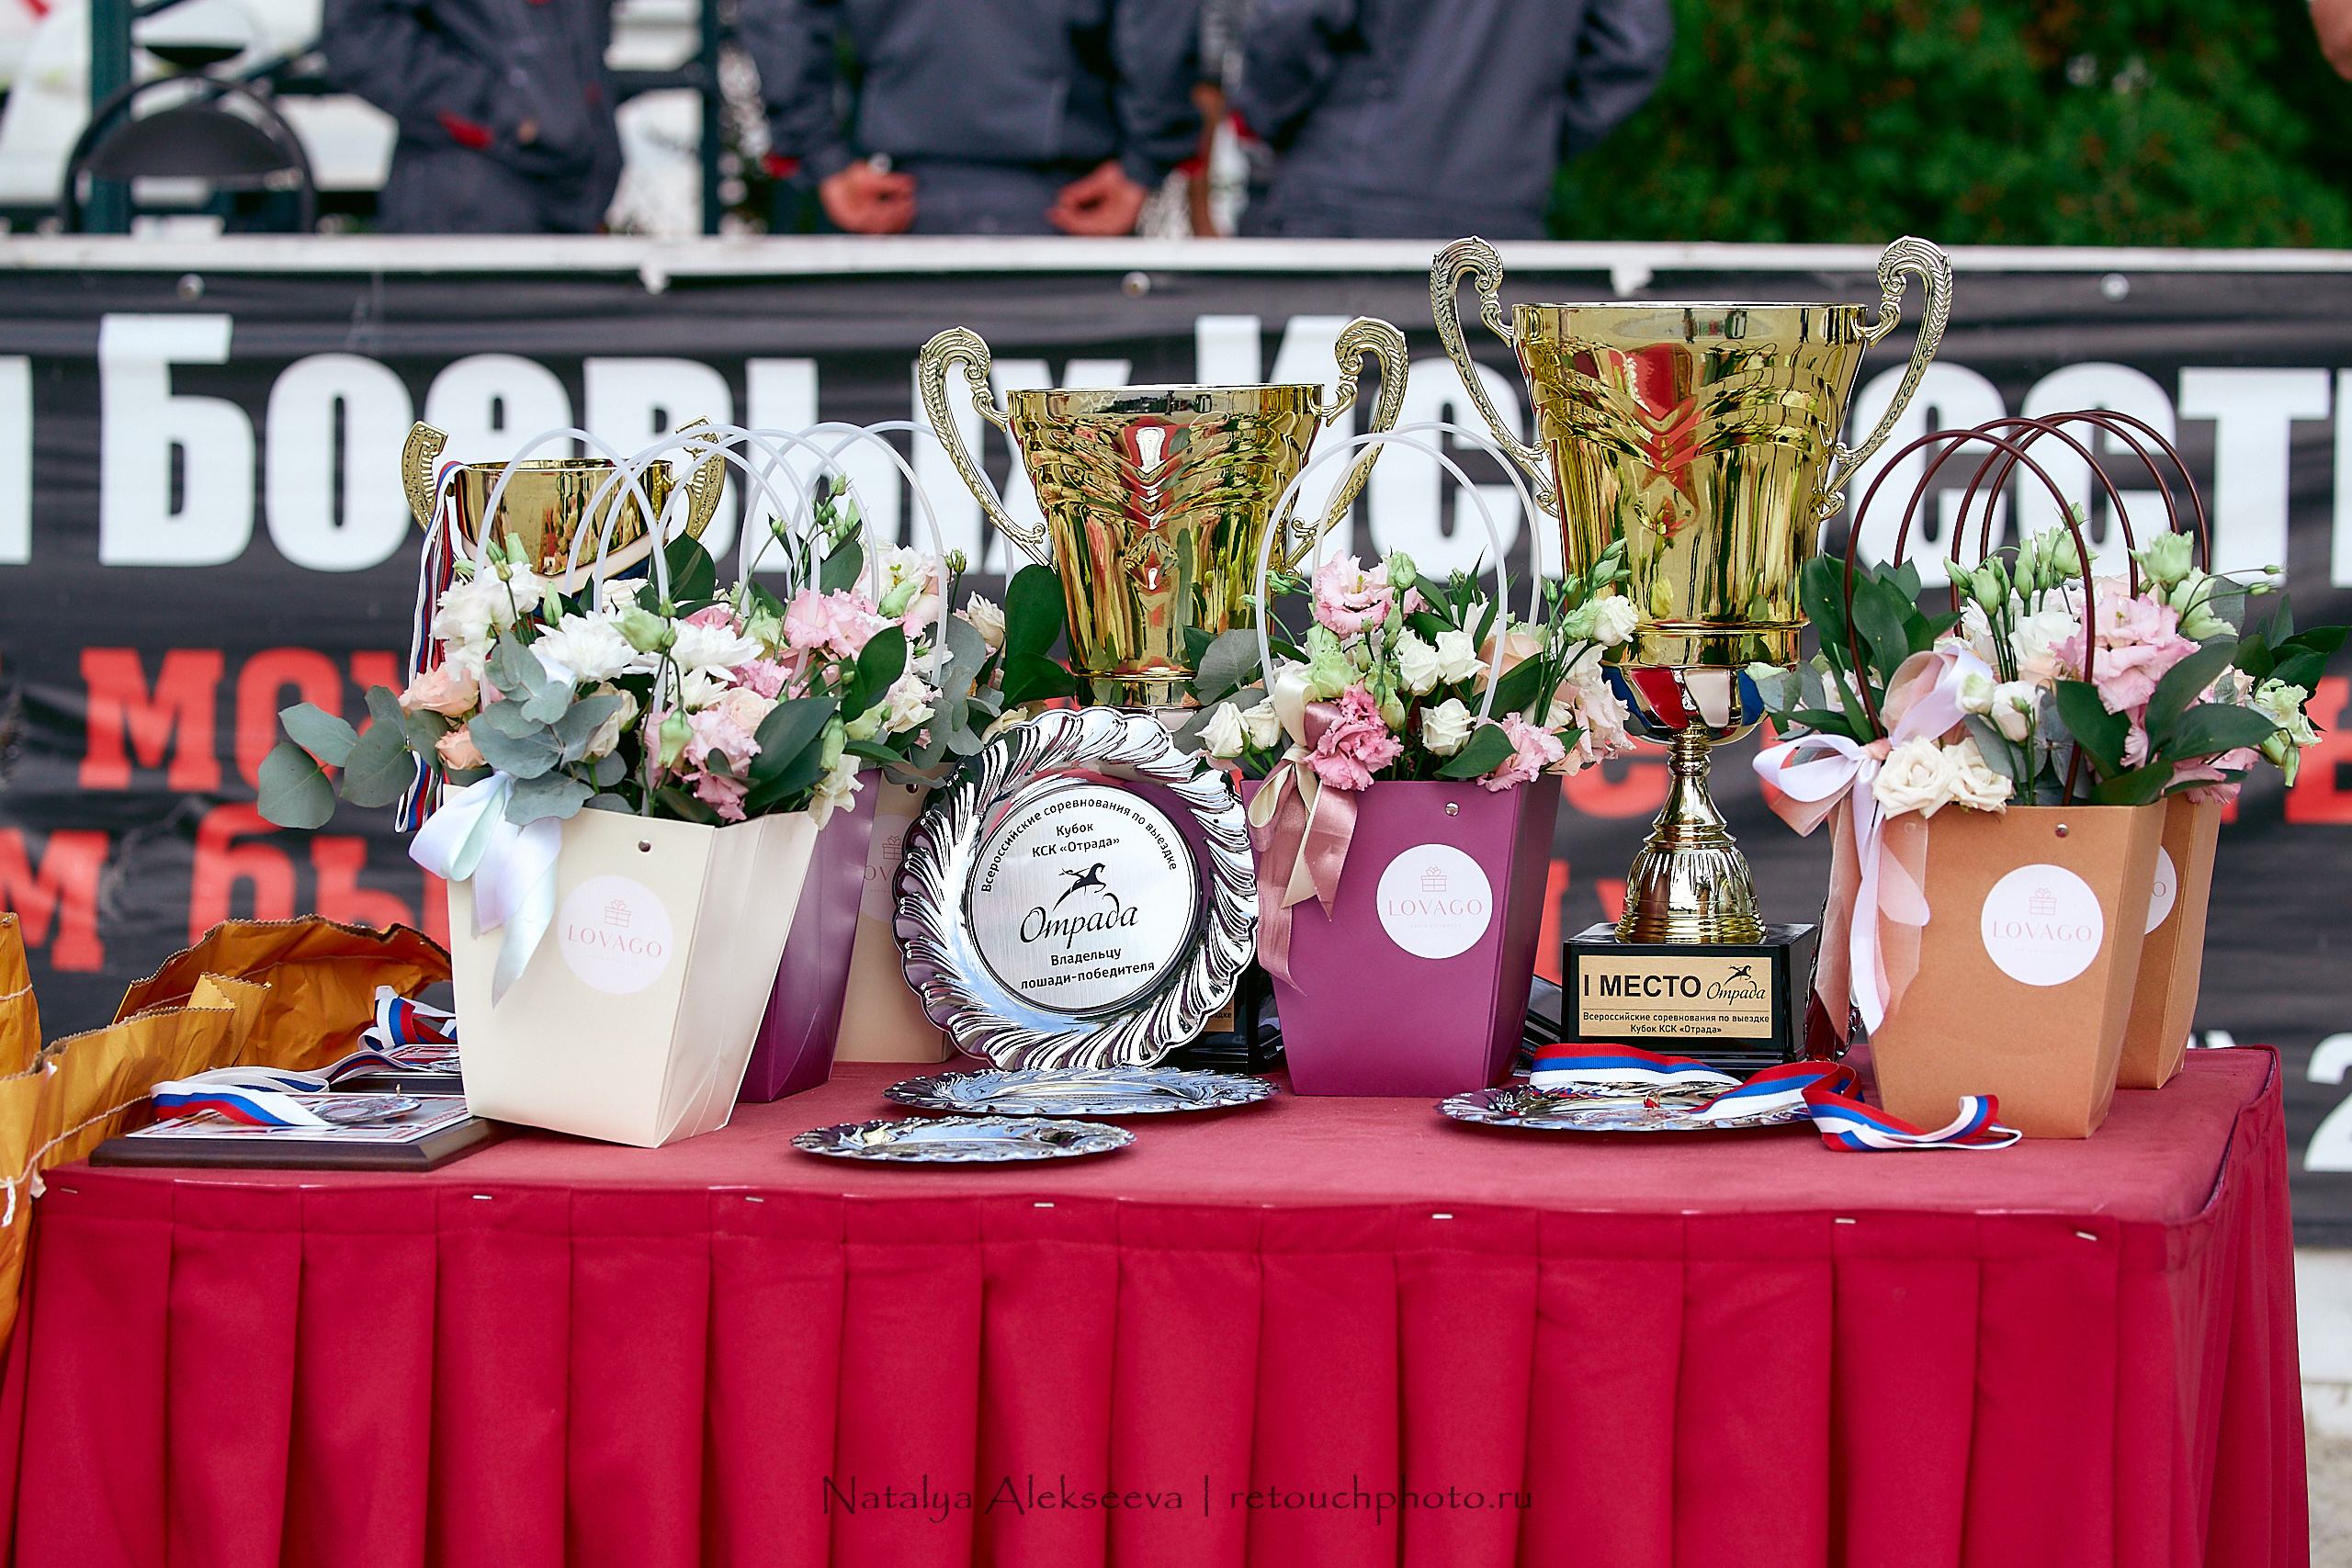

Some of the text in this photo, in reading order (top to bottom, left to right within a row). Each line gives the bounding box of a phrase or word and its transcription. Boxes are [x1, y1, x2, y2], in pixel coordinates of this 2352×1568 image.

[1056, 823, 1093, 839] Кубок
[981, 798, 1178, 893] Всероссийские соревнования по выездке
[1033, 838, 1120, 858] КСК «Отрада»
[1388, 899, 1482, 916] LOVAGO
[1020, 892, 1139, 949] Отрада
[1993, 920, 2092, 942] LOVAGO
[568, 924, 662, 957] LOVAGO
[1050, 948, 1122, 967] Владельцу
[1021, 960, 1155, 990] лошади-победителя
[1600, 975, 1702, 998] МЕСТО
[1706, 980, 1767, 1006] Отрада
[1583, 1011, 1651, 1022] Всероссийские
[1653, 1014, 1716, 1023] соревнования
[1732, 1015, 1770, 1023] выездке
[1630, 1024, 1722, 1034] Кубок КСК «Отрада»
